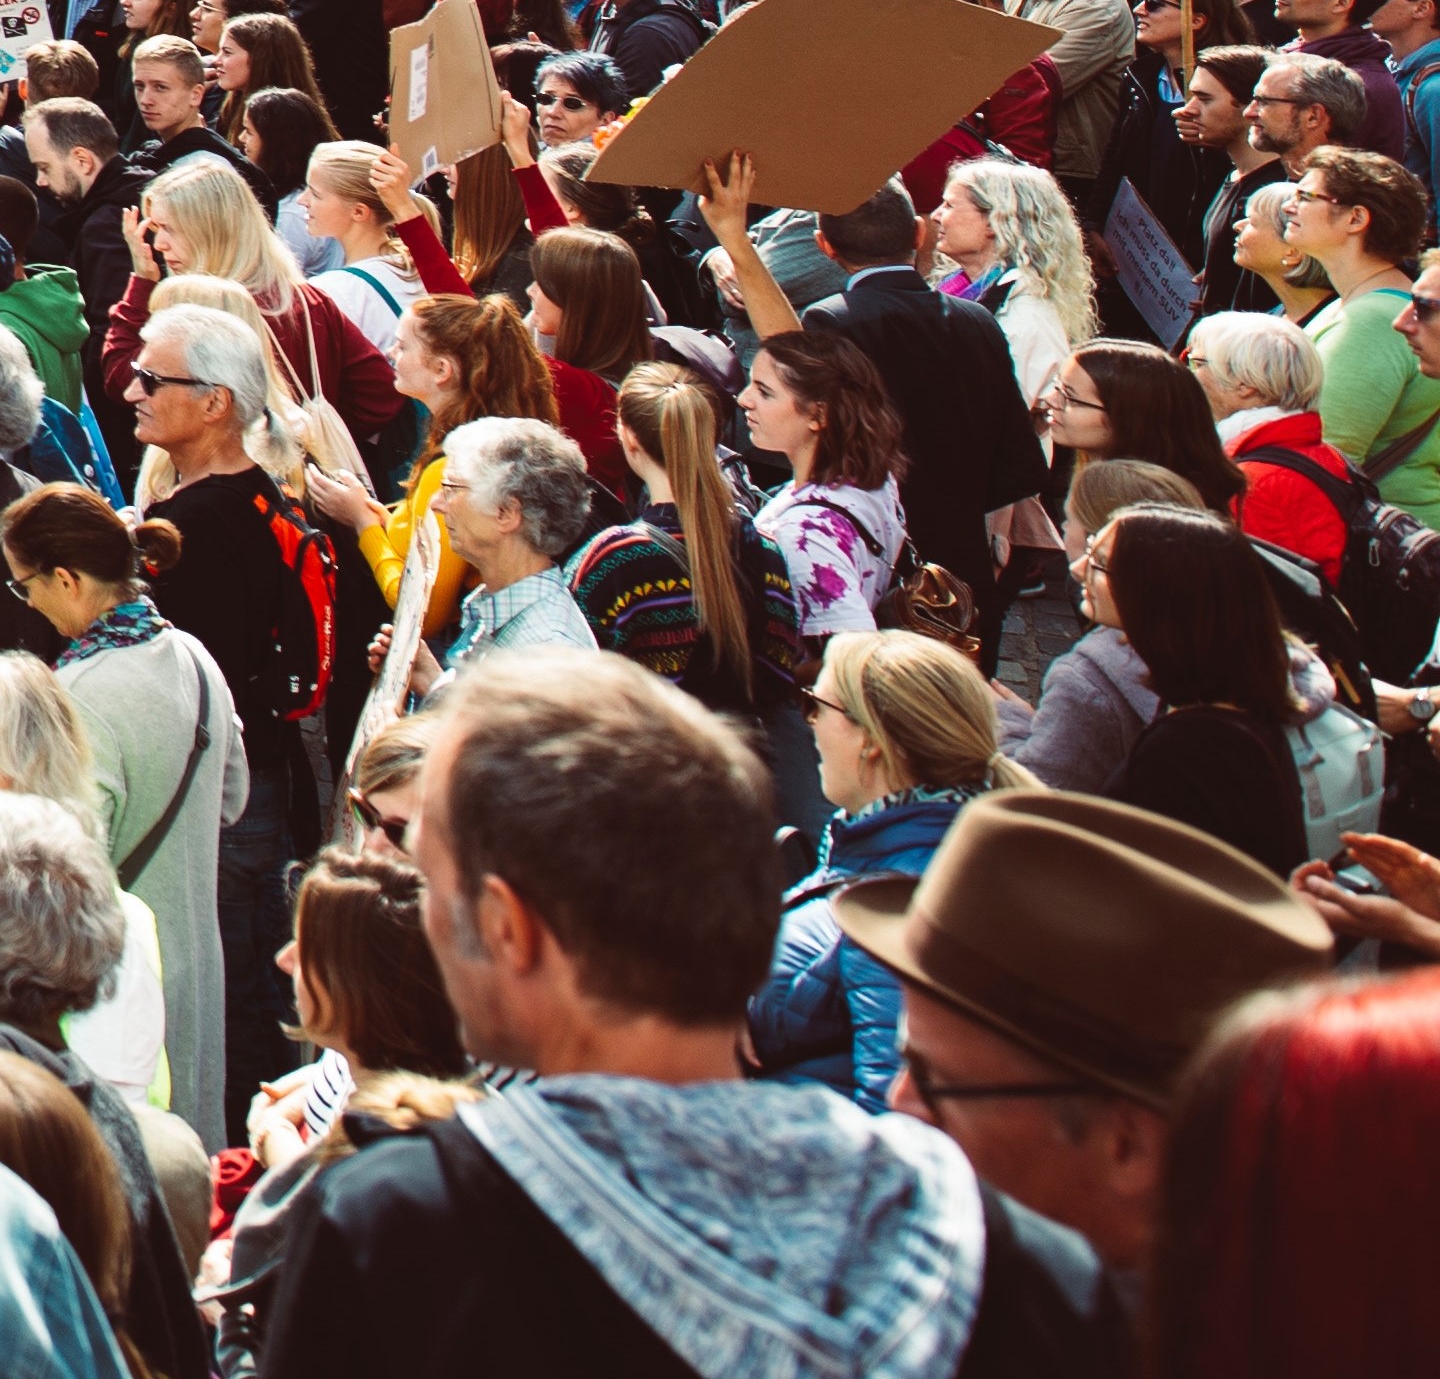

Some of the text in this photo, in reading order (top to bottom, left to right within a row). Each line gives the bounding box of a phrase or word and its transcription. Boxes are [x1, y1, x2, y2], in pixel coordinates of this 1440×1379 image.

[1113, 229, 1127, 252] mit
[1126, 251, 1159, 299] meinem
[1129, 232, 1151, 263] muss
[1150, 261, 1162, 276] da
[1161, 275, 1188, 313] durch
